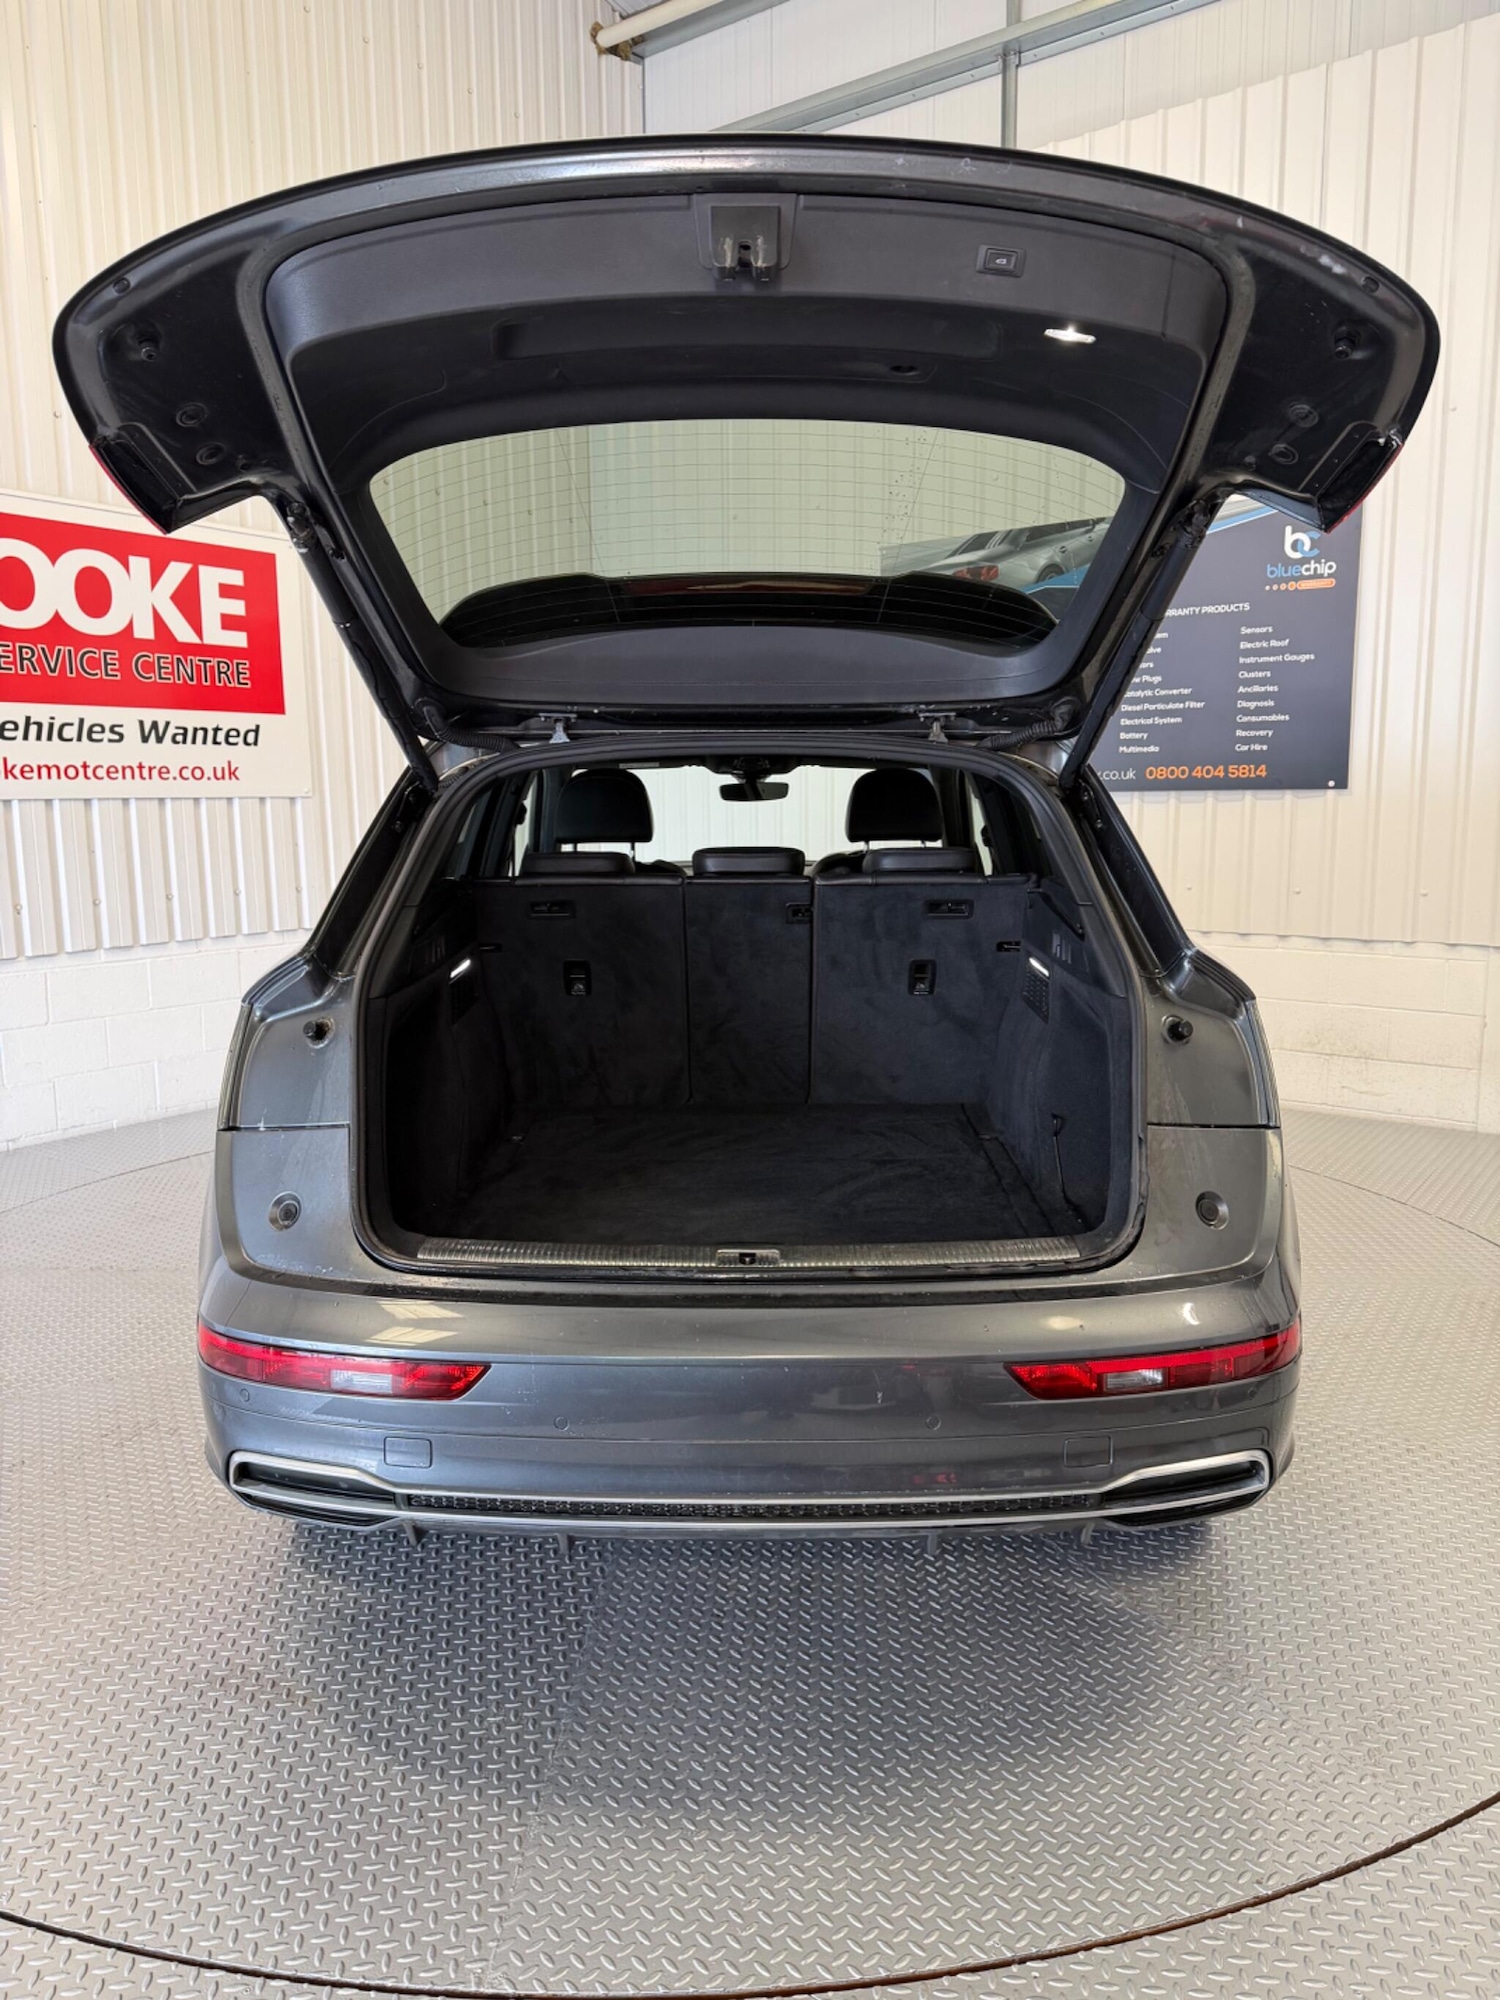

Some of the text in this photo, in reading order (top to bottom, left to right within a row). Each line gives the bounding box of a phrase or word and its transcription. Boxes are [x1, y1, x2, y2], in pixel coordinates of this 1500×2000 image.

[1266, 559, 1337, 578] bluechip
[0, 537, 248, 648] OOKE
[1201, 603, 1250, 615] PRODUCTS
[1240, 626, 1273, 635] Sensors
[1240, 639, 1290, 650] Electric Roof
[1239, 653, 1315, 664] Instrument Gauges
[132, 652, 251, 689] CENTRE
[1238, 670, 1271, 679] Clusters
[1142, 675, 1162, 685] Plugs
[1154, 687, 1192, 696] Converter
[1237, 684, 1279, 694] Ancillaries
[1121, 700, 1206, 712] Diesel Particulate Filter
[1237, 699, 1275, 710] Diagnosis
[1120, 716, 1183, 726] Electrical System
[1236, 713, 1290, 723] Consumables
[0, 715, 261, 747] ehicles Wanted
[1119, 731, 1149, 741] Battery
[1236, 729, 1274, 738] Recovery
[1118, 744, 1160, 754] Multimedia
[1235, 743, 1268, 752] Car Hire
[0, 757, 240, 781] kemotcentre.co.uk
[1145, 766, 1189, 780] 0800
[1191, 765, 1225, 779] 404
[1228, 764, 1267, 779] 5814
